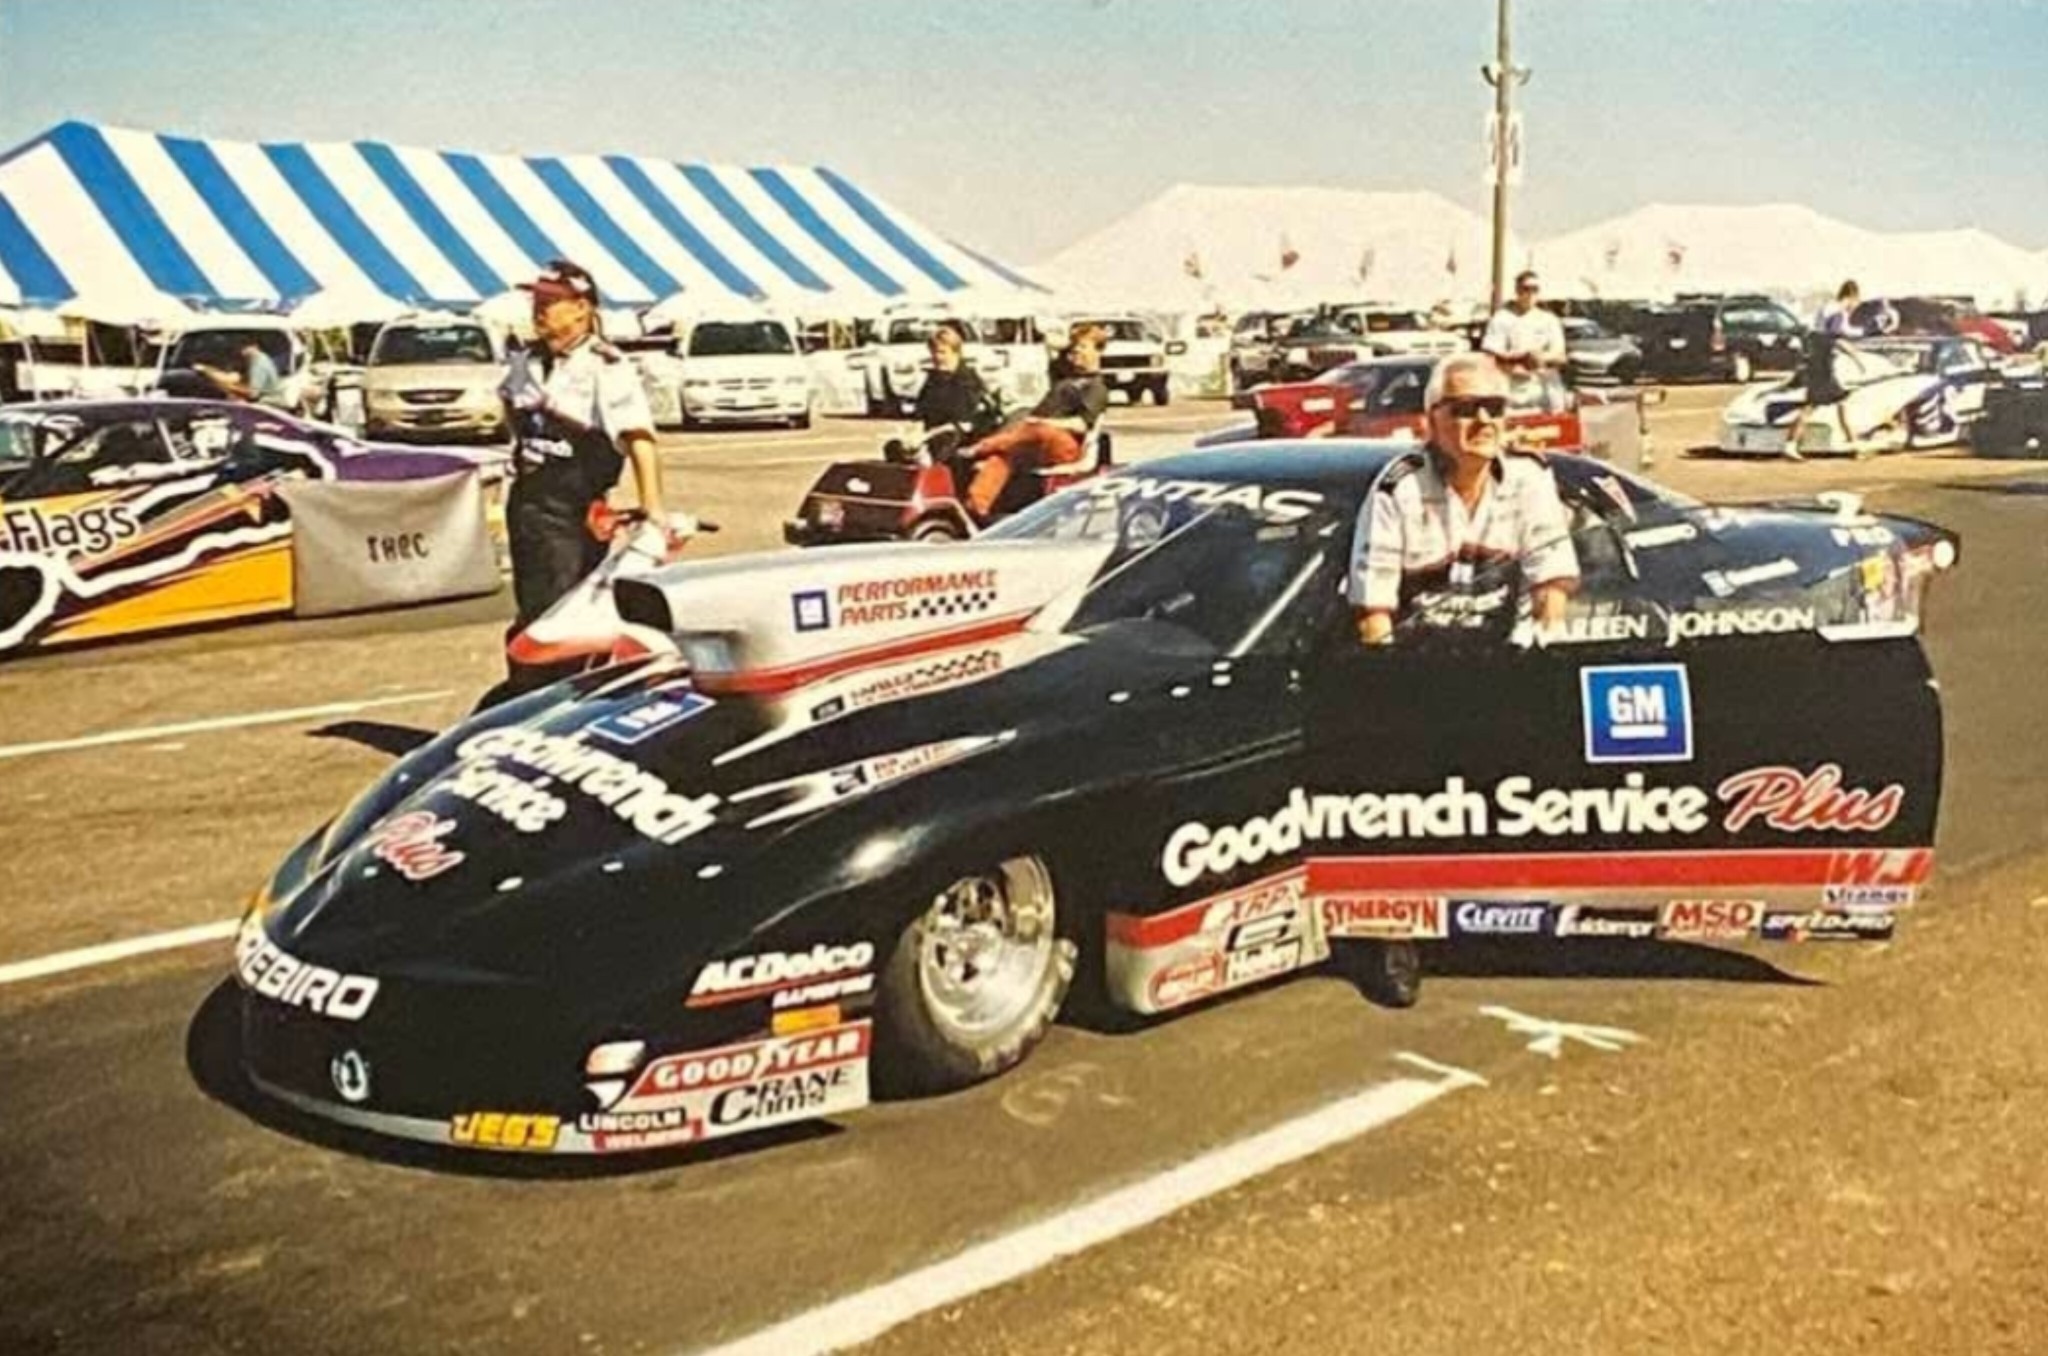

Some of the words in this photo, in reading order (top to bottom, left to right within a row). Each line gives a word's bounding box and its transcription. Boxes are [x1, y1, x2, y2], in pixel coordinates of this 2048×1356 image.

[4, 506, 136, 554] Flags
[838, 568, 999, 603] PERFORMANCE
[840, 601, 908, 626] PARTS
[1665, 606, 1815, 647] JOHNSON
[1608, 684, 1666, 723] GM
[1495, 772, 1709, 837] Service
[1717, 763, 1905, 834] Plus
[579, 1107, 682, 1132] LINCOLN
